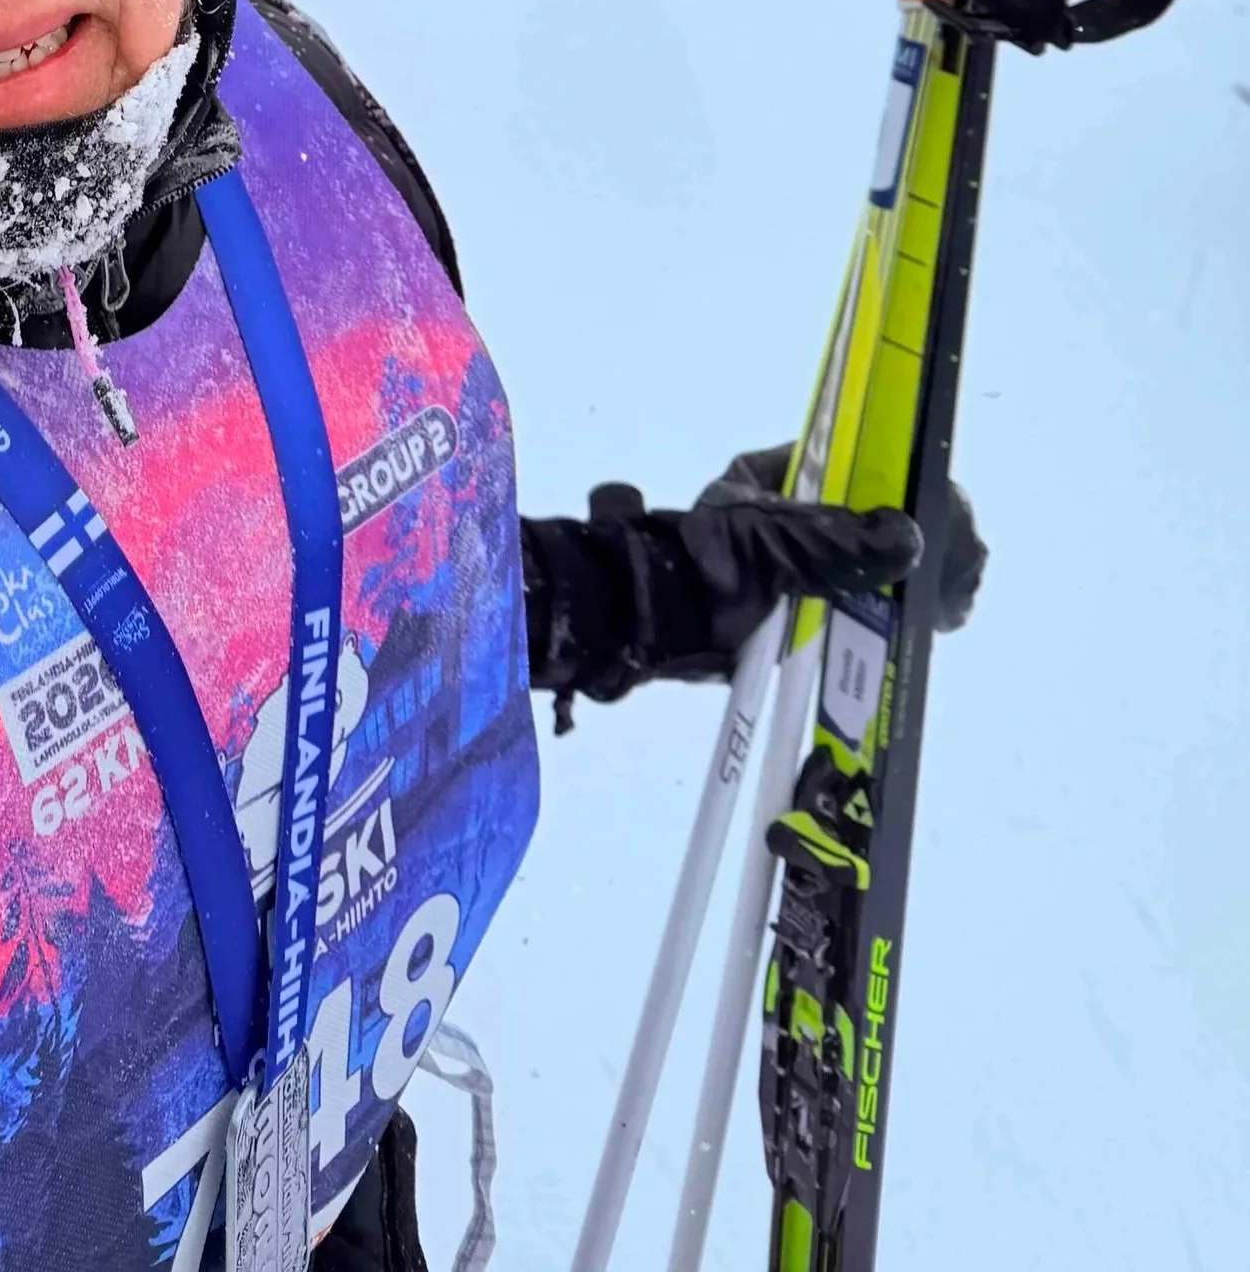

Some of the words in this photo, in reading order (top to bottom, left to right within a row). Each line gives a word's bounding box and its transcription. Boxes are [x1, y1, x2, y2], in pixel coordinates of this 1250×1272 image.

[337, 437, 426, 522] GROUP
[425, 418, 450, 459] 2
[31, 764, 94, 837] 62
[273, 606, 331, 1080] FINLANDIA-HIIH
[853, 935, 893, 1171] FISCHER
